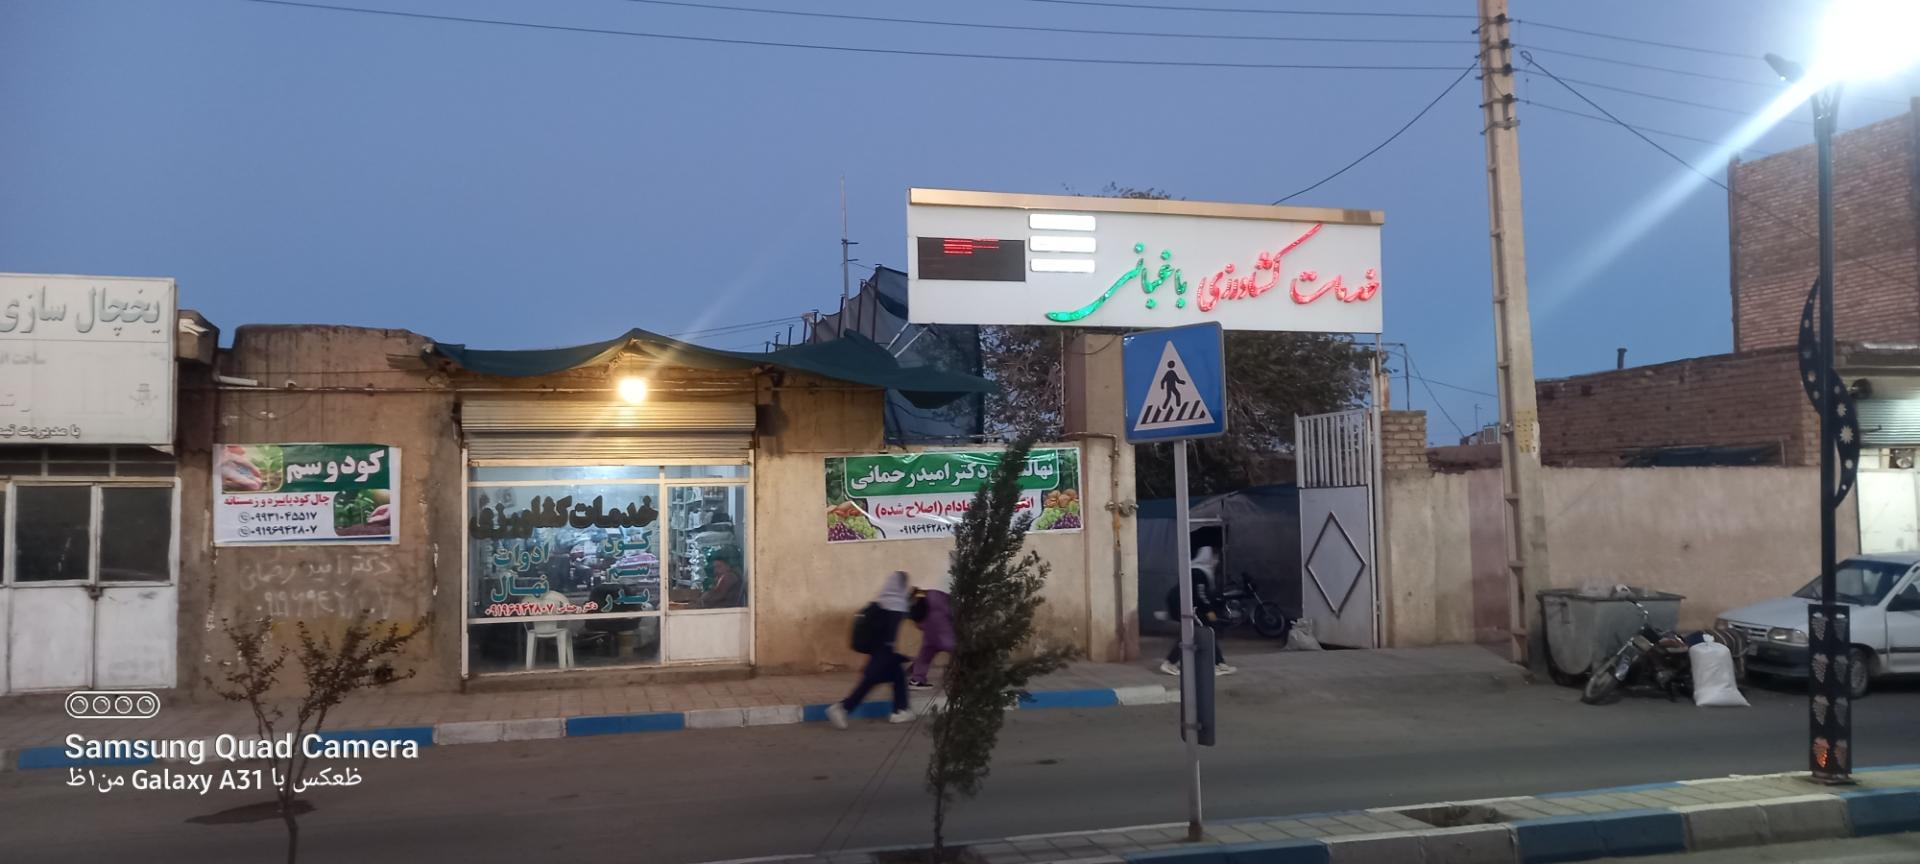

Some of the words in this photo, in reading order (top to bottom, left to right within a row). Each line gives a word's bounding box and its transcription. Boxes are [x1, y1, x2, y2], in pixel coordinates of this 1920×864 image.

[1197, 222, 1324, 312] کشاورزی
[1045, 242, 1188, 322] باغبانی
[1289, 267, 1380, 305] خدمات
[76, 286, 161, 336] یخچال
[18, 426, 69, 440] مدیریت
[70, 424, 81, 439] با
[286, 461, 322, 484] سم
[323, 459, 339, 482] و
[340, 450, 385, 482] کود
[850, 464, 916, 490] رحمانی
[916, 462, 951, 486] امید
[951, 461, 988, 486] دکتر
[292, 494, 310, 506] کود
[568, 495, 659, 530] خدمات
[492, 540, 551, 572] ادوات
[603, 530, 653, 559] کود
[606, 564, 651, 584] سم
[491, 574, 550, 602] نهال
